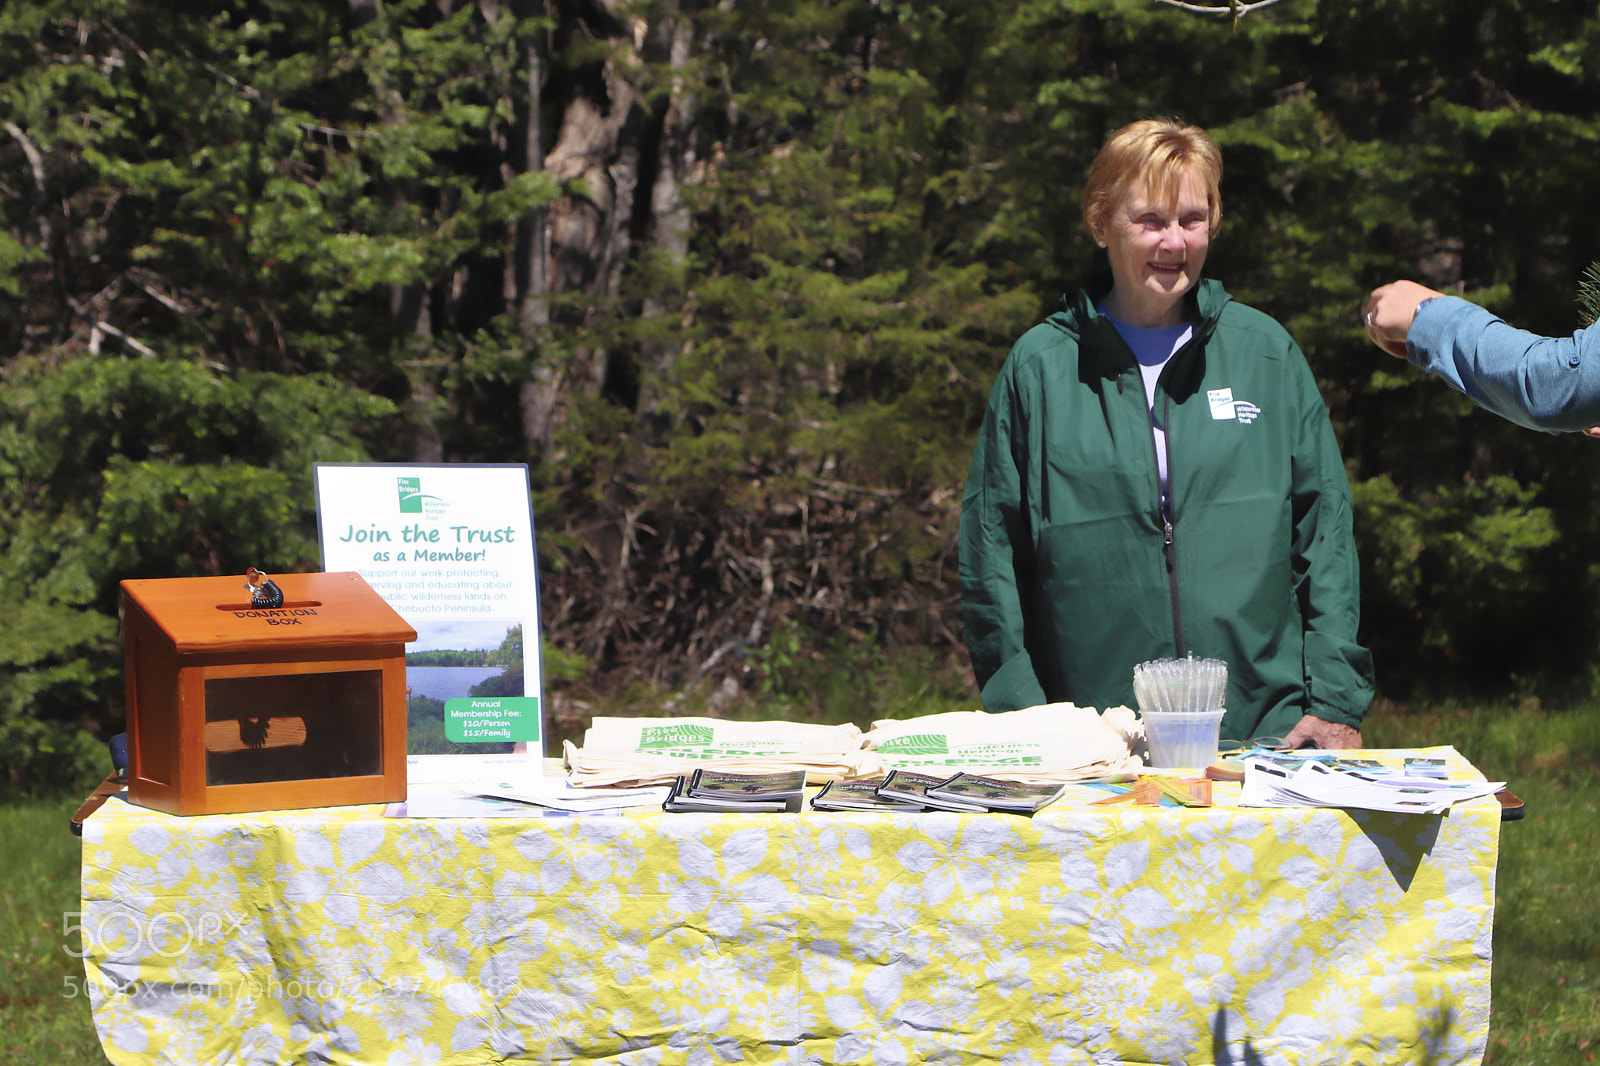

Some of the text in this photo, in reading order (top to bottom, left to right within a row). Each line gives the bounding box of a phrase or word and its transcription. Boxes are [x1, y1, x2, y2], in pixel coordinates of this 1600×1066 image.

[339, 523, 516, 543] Join the Trust
[373, 547, 486, 562] as a Member!
[358, 568, 398, 579] Support
[400, 569, 417, 577] our
[420, 569, 444, 577] work
[369, 580, 512, 591] erving and educating about
[410, 591, 462, 601] wilderness
[464, 591, 492, 601] lands
[493, 592, 507, 601] on
[232, 609, 318, 618] DONATION
[265, 618, 303, 626] BOX
[471, 700, 501, 708] Annual
[450, 709, 523, 719] Membership Fee:
[462, 719, 512, 729] $10/Person
[463, 728, 511, 739] $15/Family
